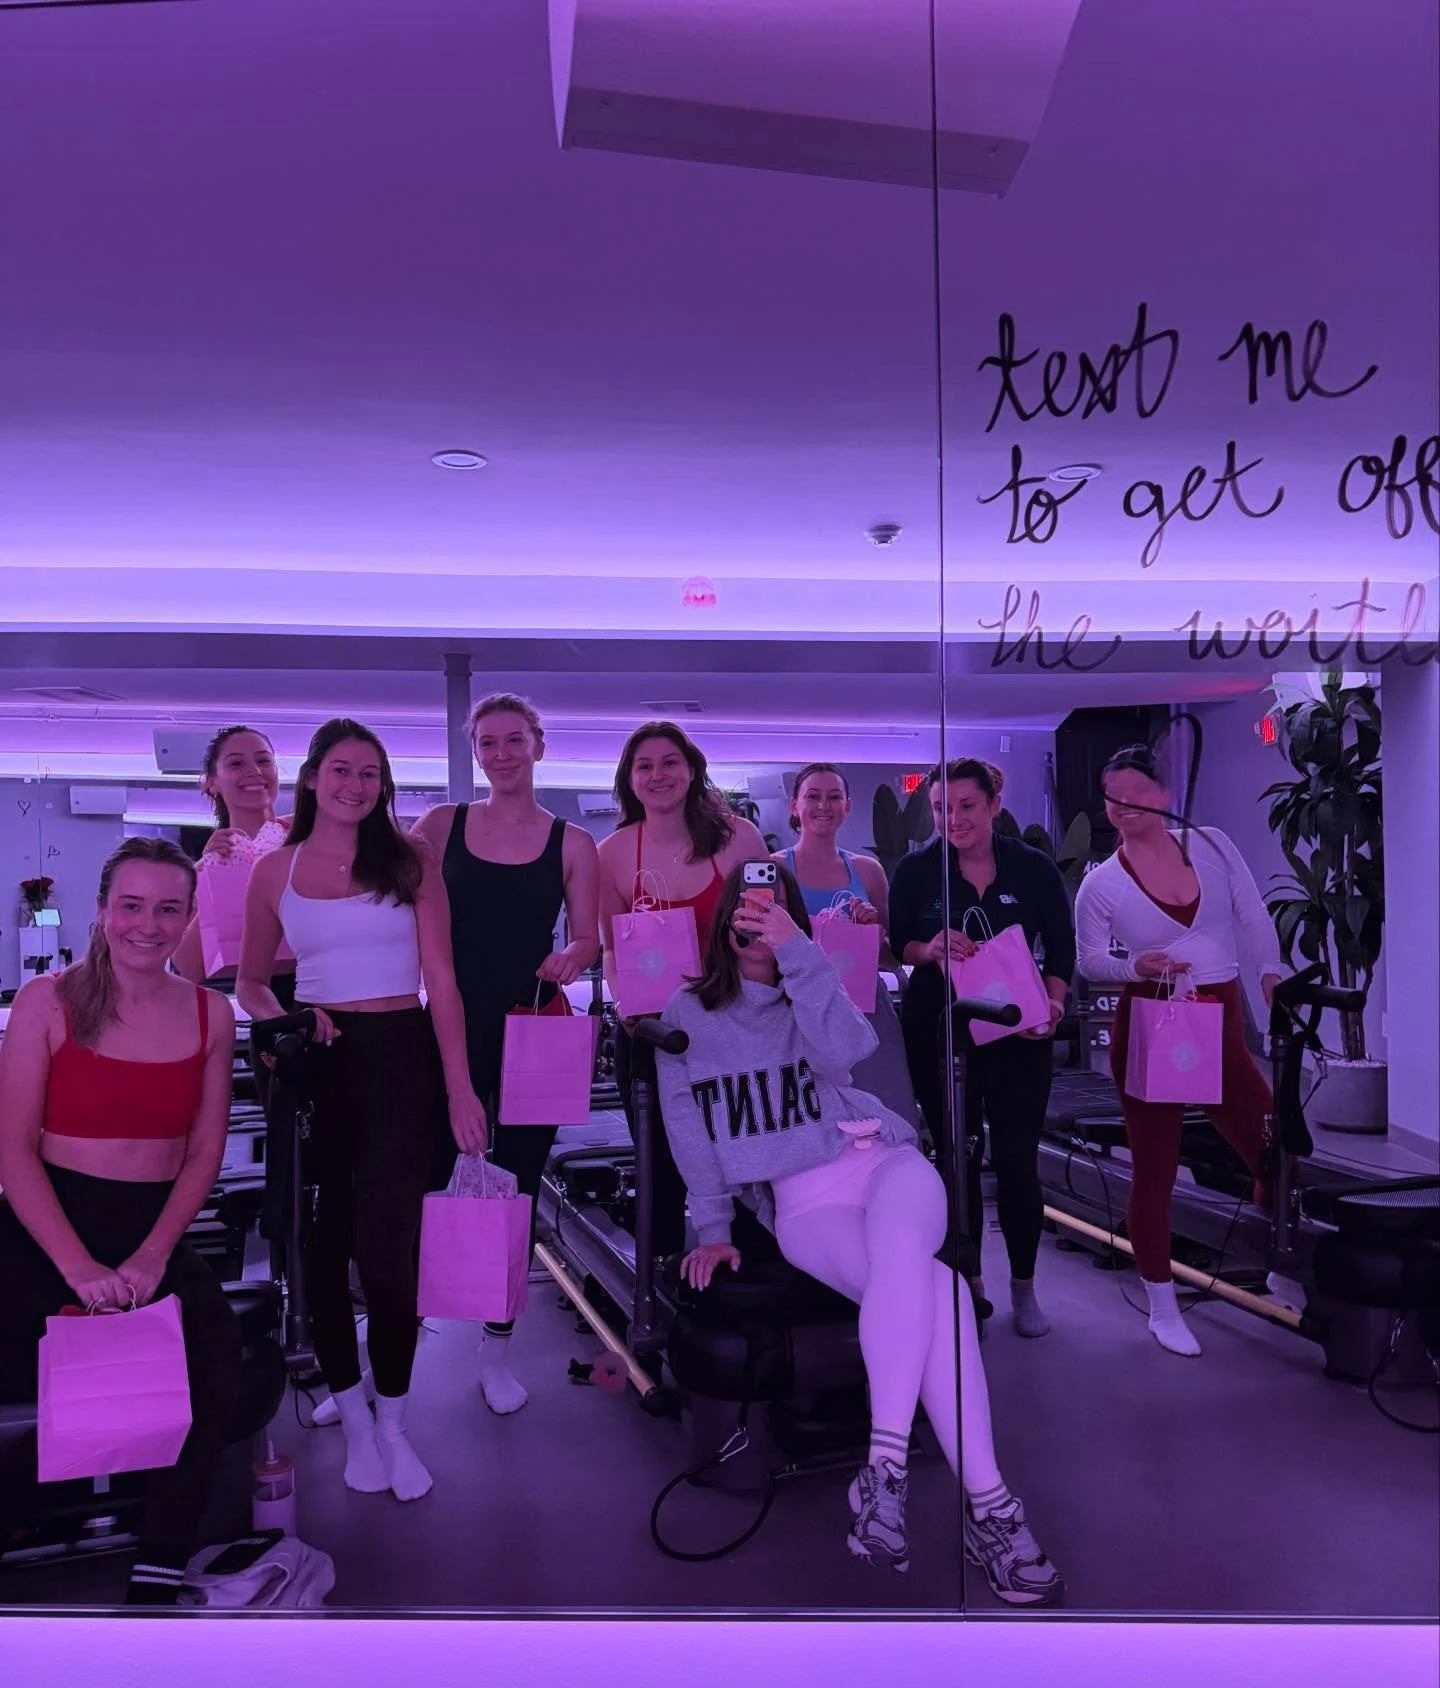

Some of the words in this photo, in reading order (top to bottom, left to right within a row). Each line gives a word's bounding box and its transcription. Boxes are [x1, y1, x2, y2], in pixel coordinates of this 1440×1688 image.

[978, 302, 1179, 433] text
[1217, 319, 1379, 404] me
[976, 444, 1089, 544] to
[1123, 440, 1285, 568] get
[977, 584, 1122, 671] the
[1173, 577, 1439, 666] waitl
